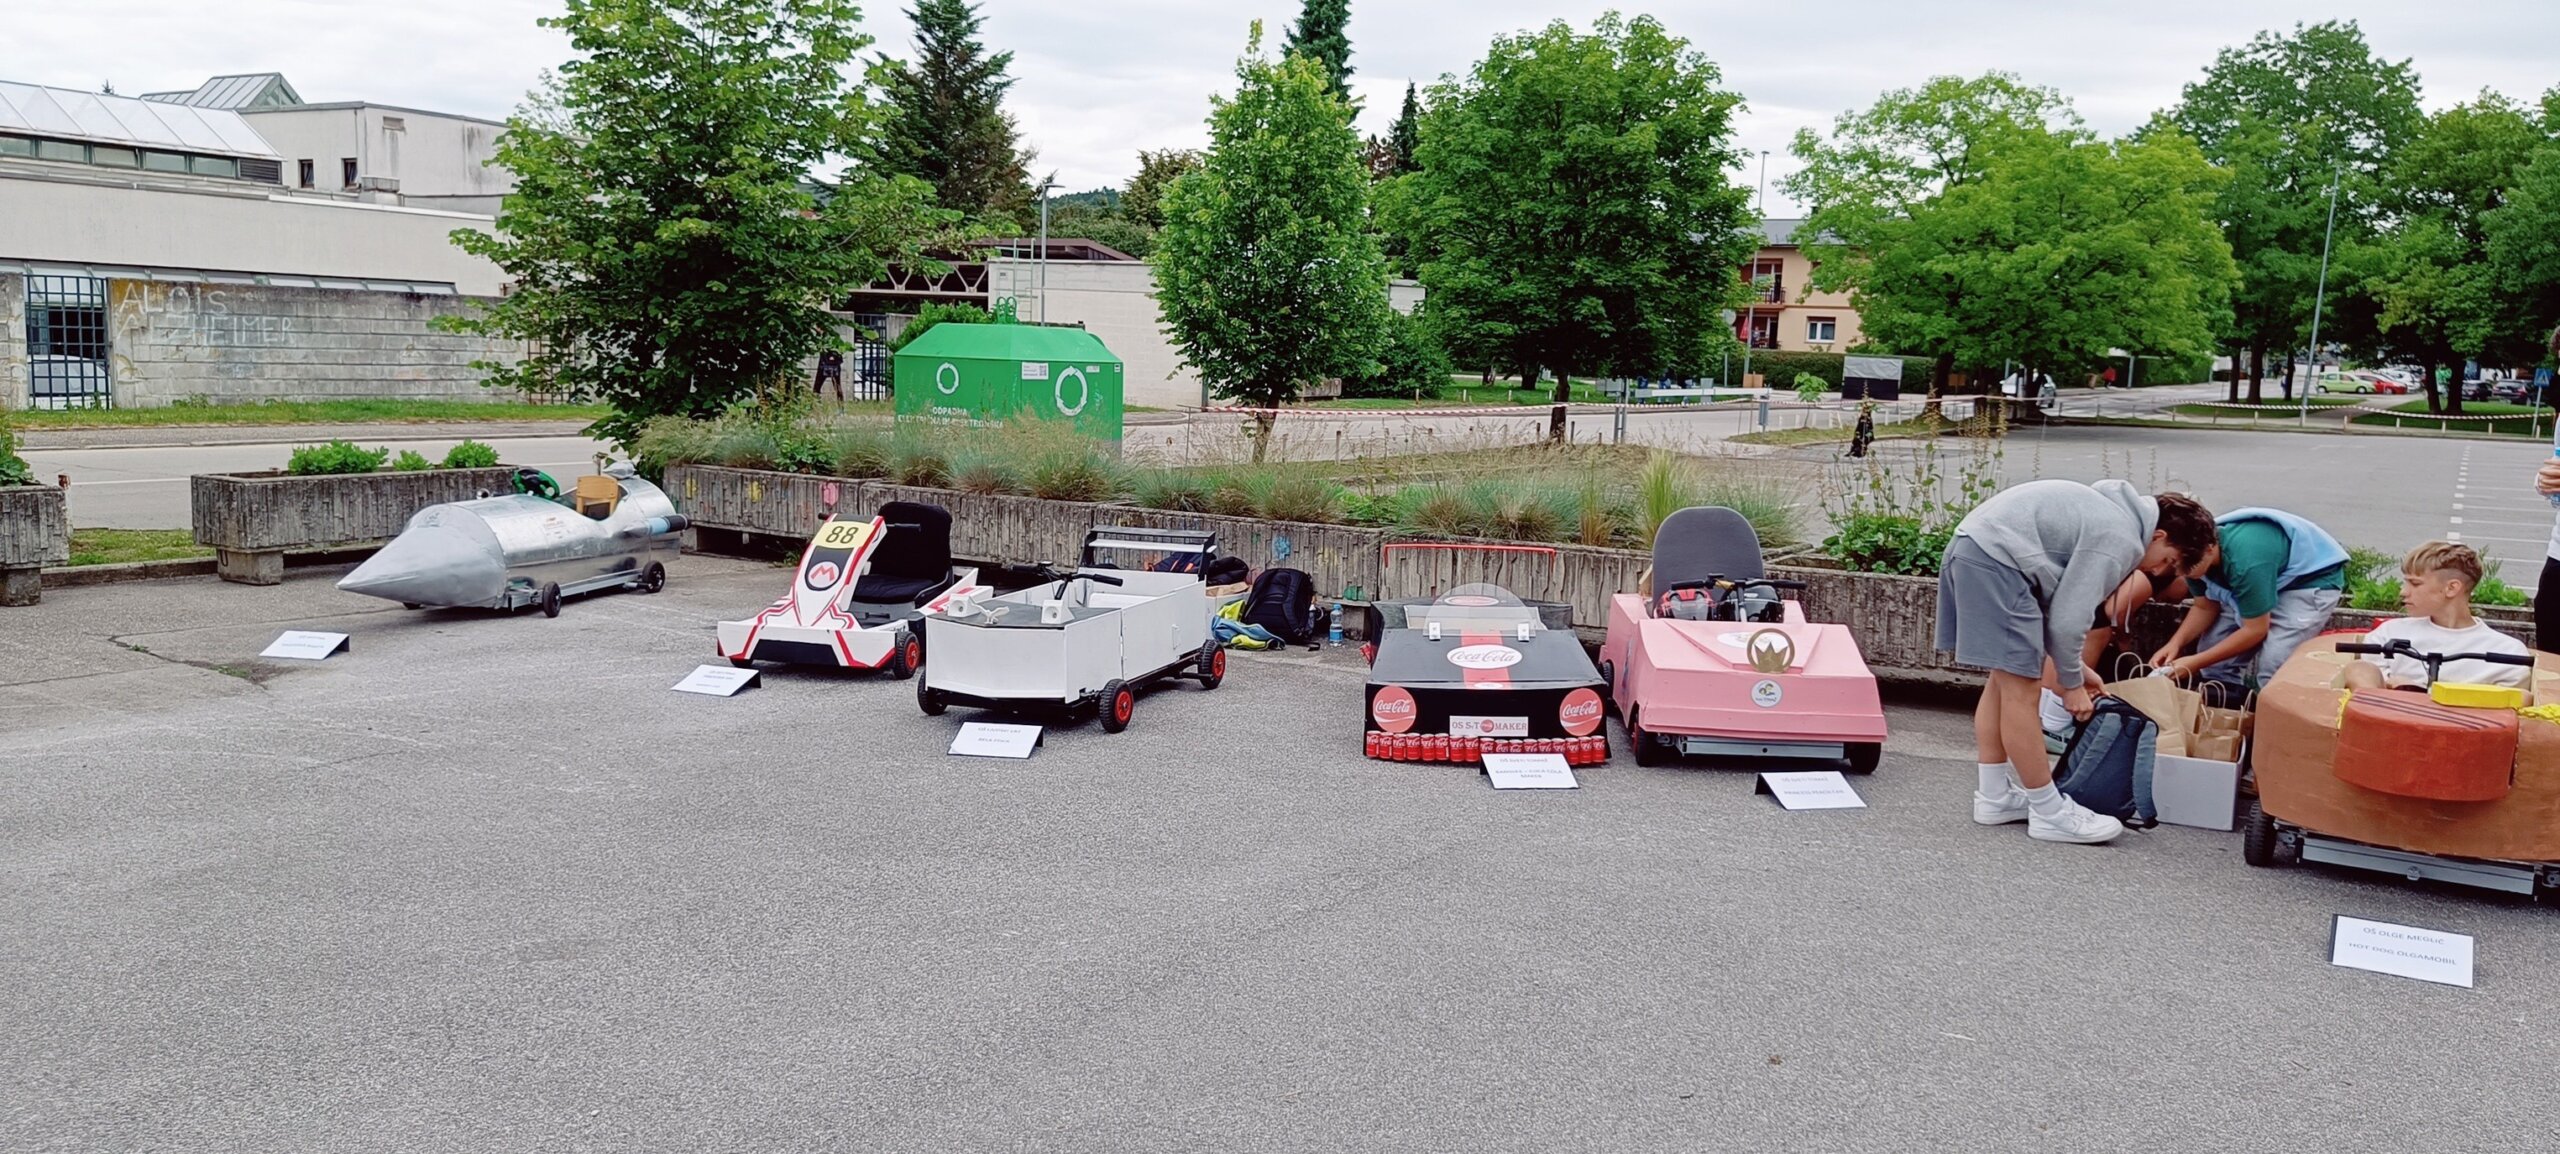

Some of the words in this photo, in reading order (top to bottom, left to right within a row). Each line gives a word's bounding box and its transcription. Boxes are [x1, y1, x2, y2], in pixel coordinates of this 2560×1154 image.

[119, 282, 228, 315] ALOIS
[825, 525, 859, 544] 88
[810, 565, 835, 581] M
[1495, 722, 1527, 731] MAKER
[2378, 930, 2404, 940] OLGE
[2348, 942, 2369, 950] HOT
[2372, 946, 2395, 955] DOG
[2396, 949, 2457, 965] OLGAMOBIL
